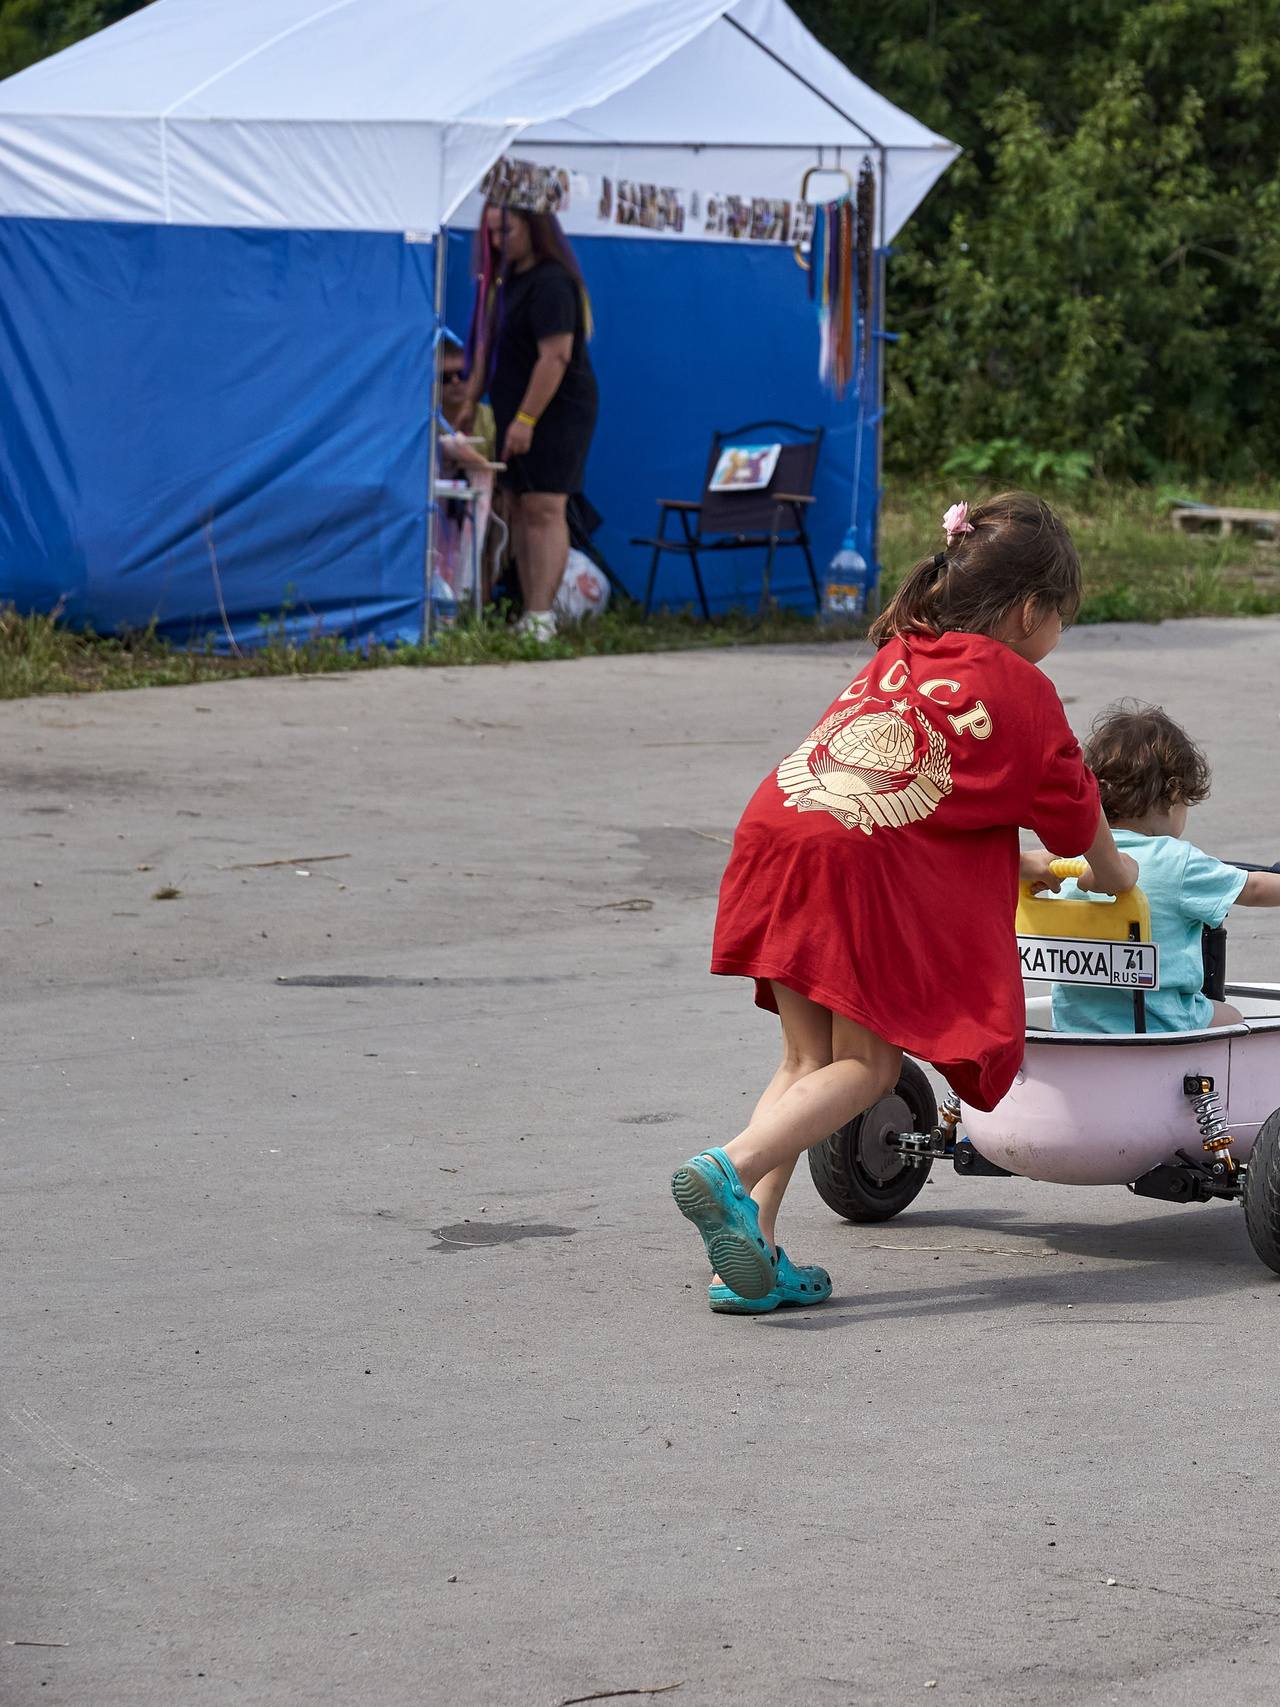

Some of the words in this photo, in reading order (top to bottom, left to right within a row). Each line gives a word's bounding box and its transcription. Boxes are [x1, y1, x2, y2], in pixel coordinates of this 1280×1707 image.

[1019, 946, 1109, 977] КАТЮХА
[1123, 949, 1143, 970] 71
[1114, 971, 1138, 983] RUS
